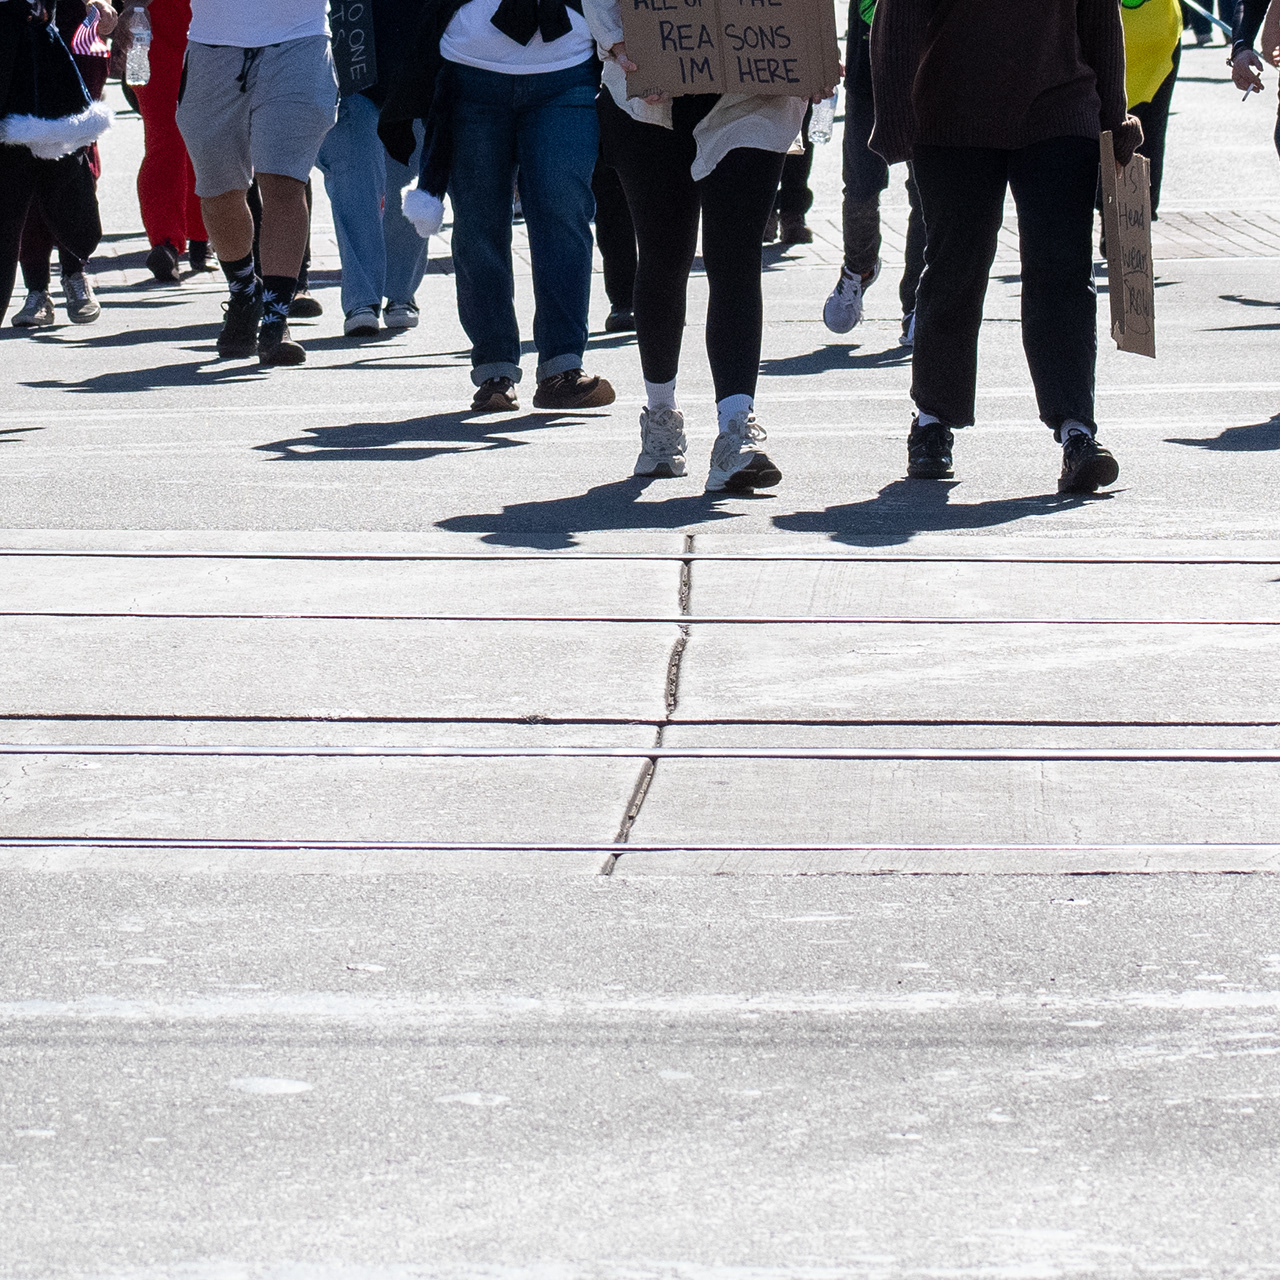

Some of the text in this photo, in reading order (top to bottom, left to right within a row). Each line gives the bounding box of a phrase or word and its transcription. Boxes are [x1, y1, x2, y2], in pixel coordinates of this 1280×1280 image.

[349, 29, 366, 80] ONE
[679, 56, 800, 84] IM HERE
